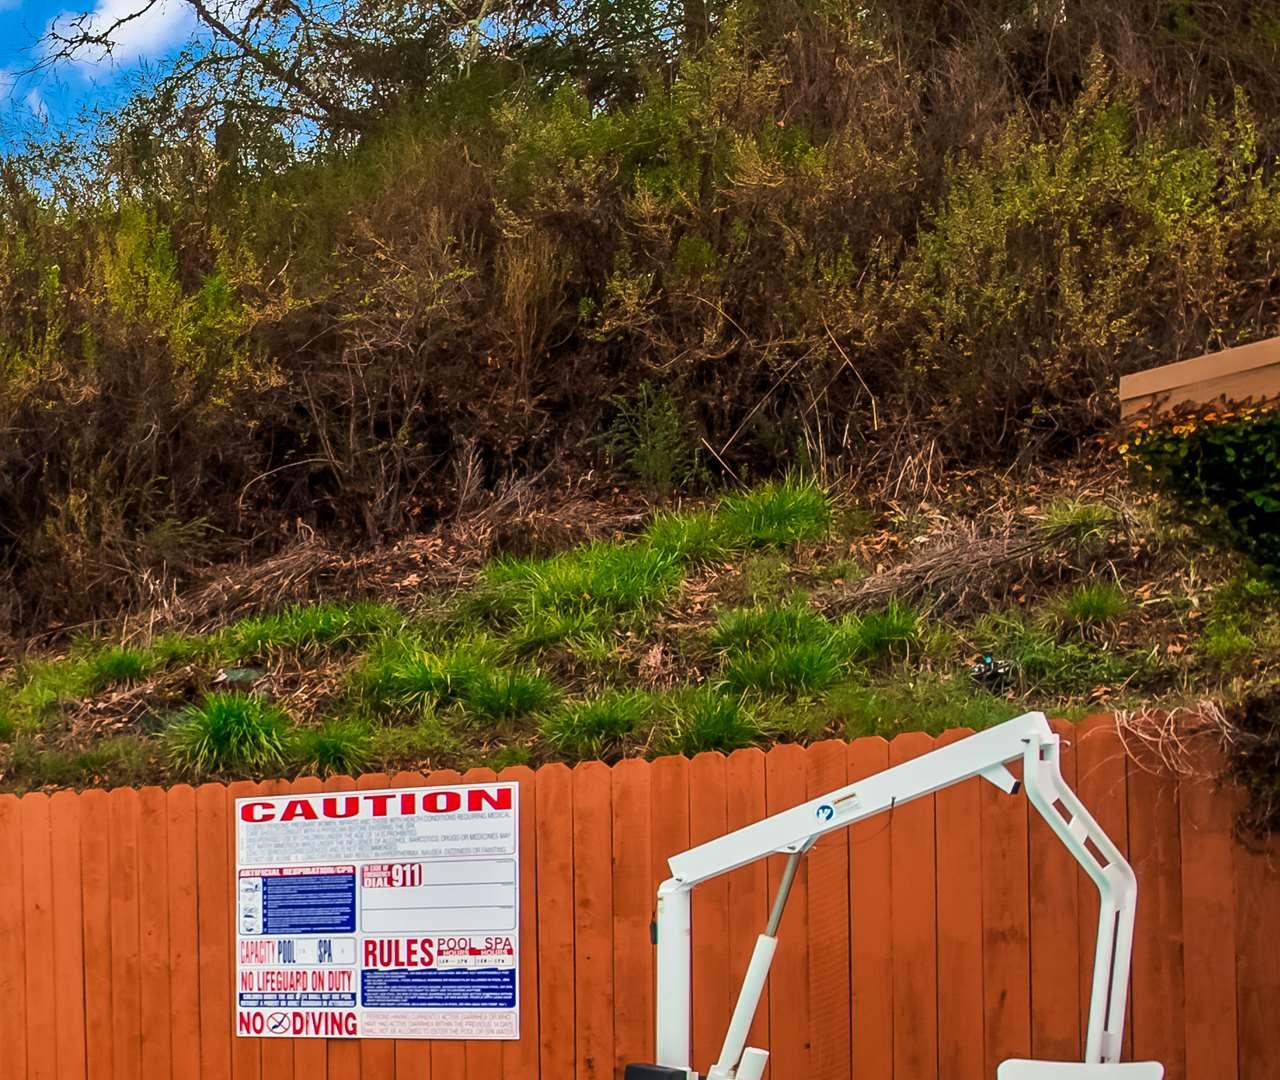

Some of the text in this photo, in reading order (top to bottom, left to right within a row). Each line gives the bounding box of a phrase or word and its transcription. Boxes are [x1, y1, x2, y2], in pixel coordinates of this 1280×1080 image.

[241, 788, 511, 822] CAUTION
[364, 864, 419, 887] DIAL 911
[241, 939, 333, 963] CAPACITY POOL SPA
[364, 938, 434, 967] RULES
[438, 937, 513, 950] POOL SPA
[241, 971, 254, 991] NO
[257, 971, 308, 991] LIFEGUARD
[311, 971, 325, 991] ON
[328, 970, 352, 991] DUTY
[239, 1011, 357, 1036] NO DIVING
